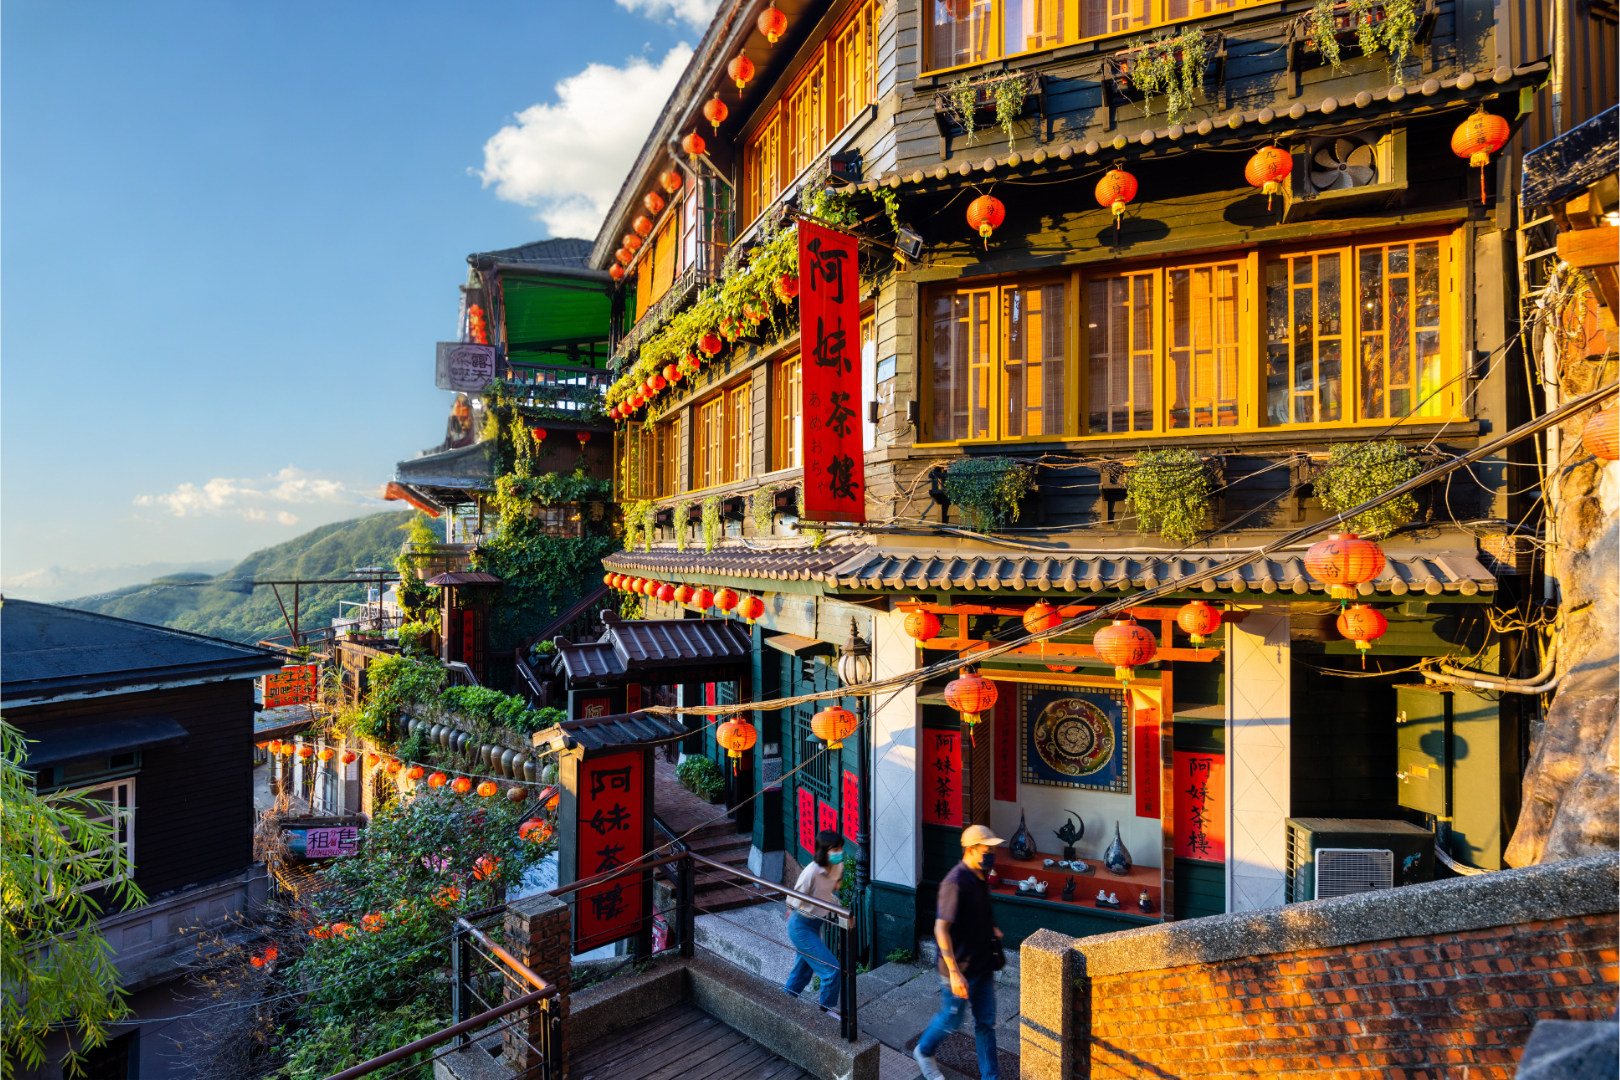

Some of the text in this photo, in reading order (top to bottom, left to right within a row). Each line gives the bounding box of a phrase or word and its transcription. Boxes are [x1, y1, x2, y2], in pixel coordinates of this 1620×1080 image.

[1110, 174, 1122, 195] 九份
[806, 237, 859, 502] 阿妹茶樓
[808, 391, 827, 496] あめおちゃ
[1323, 544, 1341, 578] 九份
[1198, 609, 1209, 631] 九份
[1354, 614, 1365, 637] 九份
[1131, 630, 1145, 661] 九份
[981, 681, 993, 706] 九份
[733, 728, 742, 749] 九份
[931, 734, 956, 822] 阿妹茶樓
[1185, 758, 1215, 855] 阿妹茶樓
[589, 765, 632, 921] 阿妹茶樓
